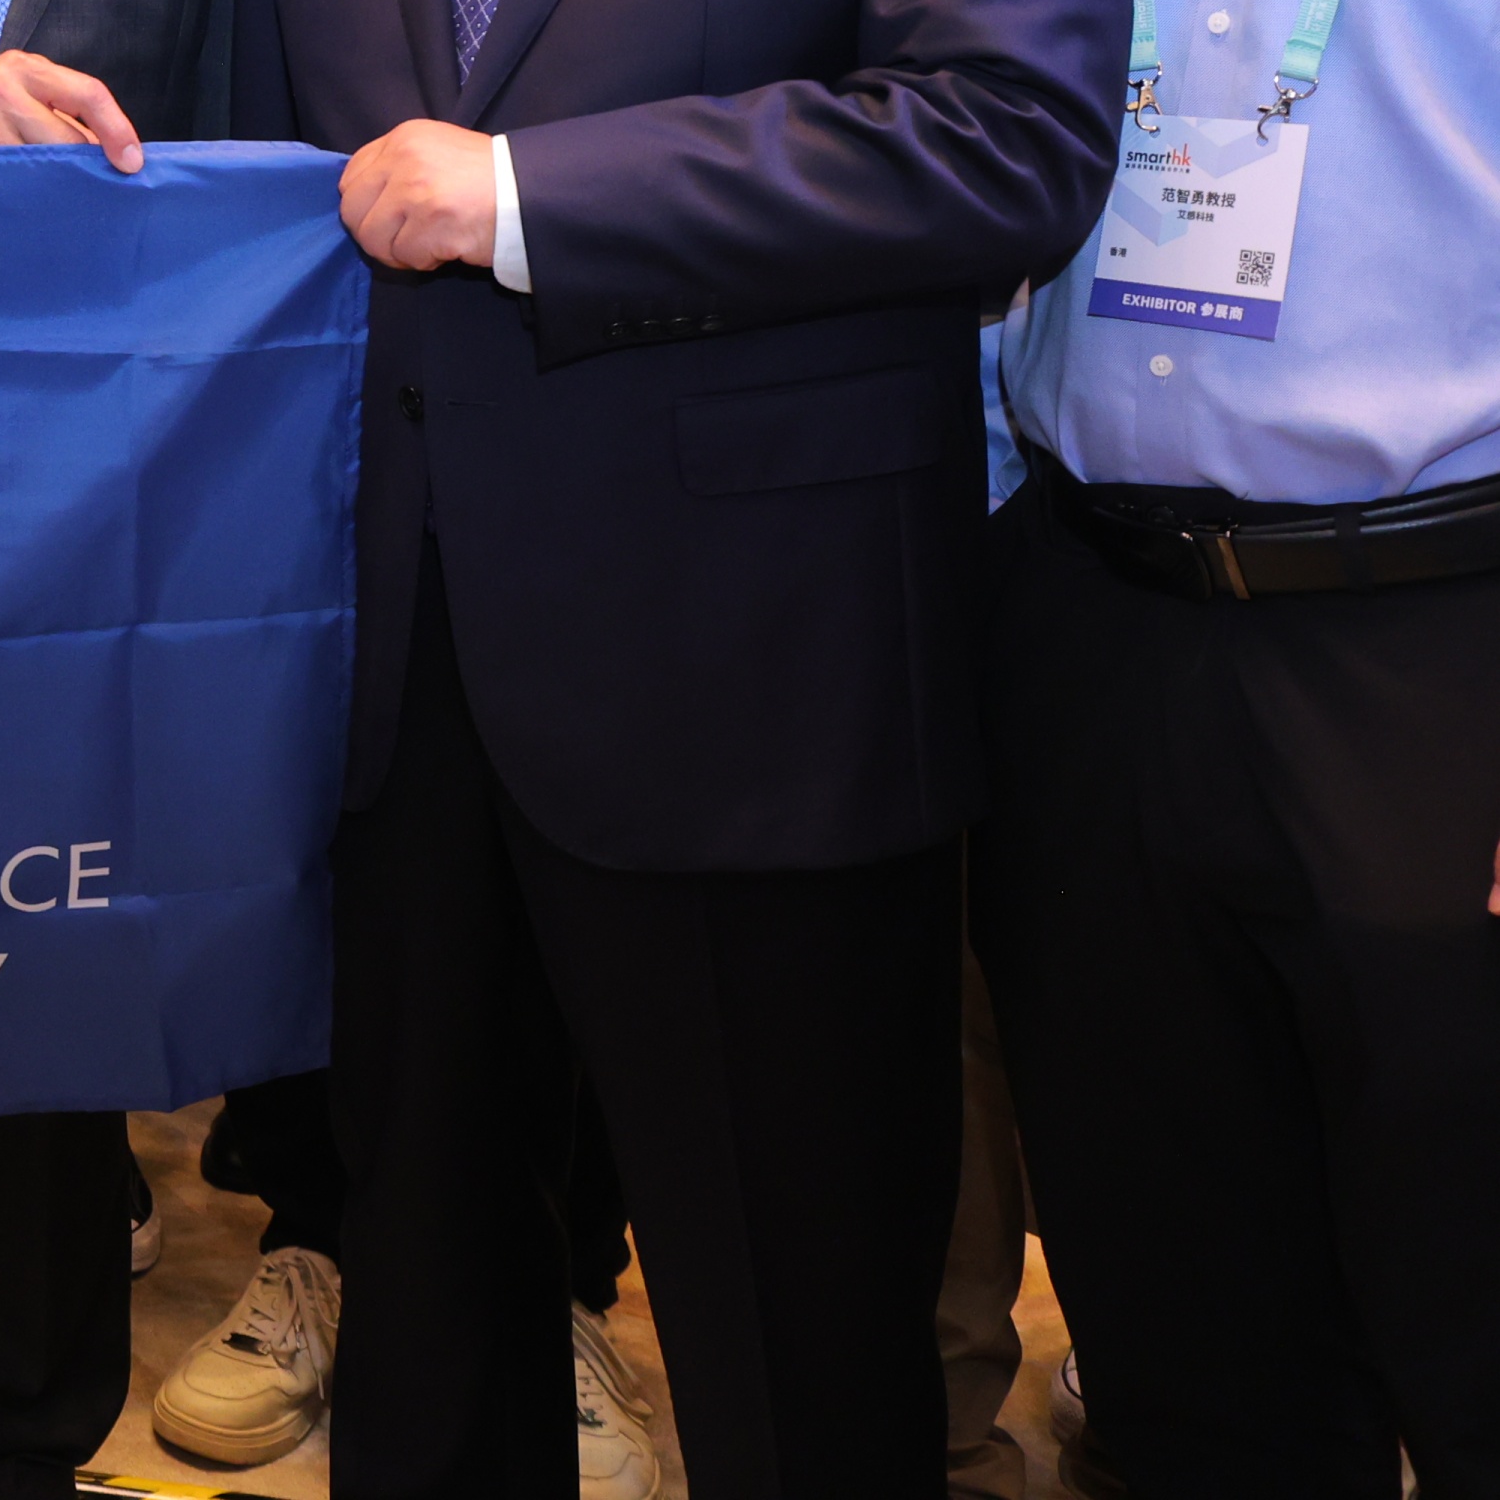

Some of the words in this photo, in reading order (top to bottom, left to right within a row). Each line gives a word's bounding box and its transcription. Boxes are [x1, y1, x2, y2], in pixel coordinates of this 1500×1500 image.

[1126, 143, 1192, 167] smarthk
[1162, 187, 1236, 208] 范智勇教授
[1121, 293, 1197, 314] EXHIBITOR
